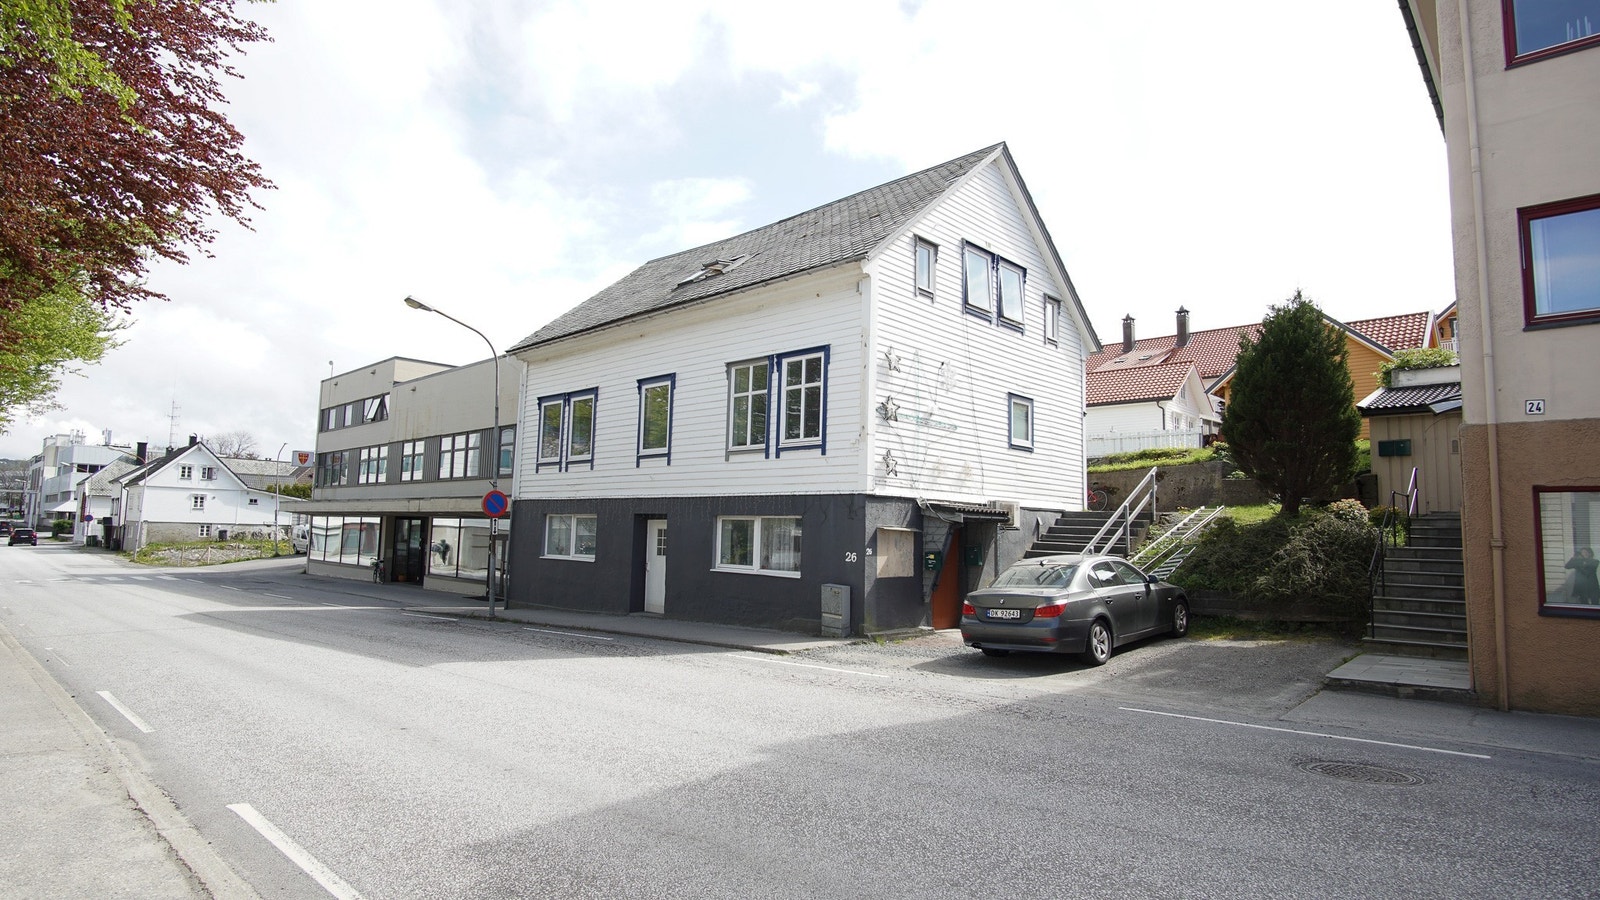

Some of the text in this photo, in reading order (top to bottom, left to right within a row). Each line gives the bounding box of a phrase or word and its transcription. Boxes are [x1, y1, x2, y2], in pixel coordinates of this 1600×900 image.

[1528, 402, 1542, 412] 24
[866, 547, 873, 556] 26
[845, 551, 857, 563] 26
